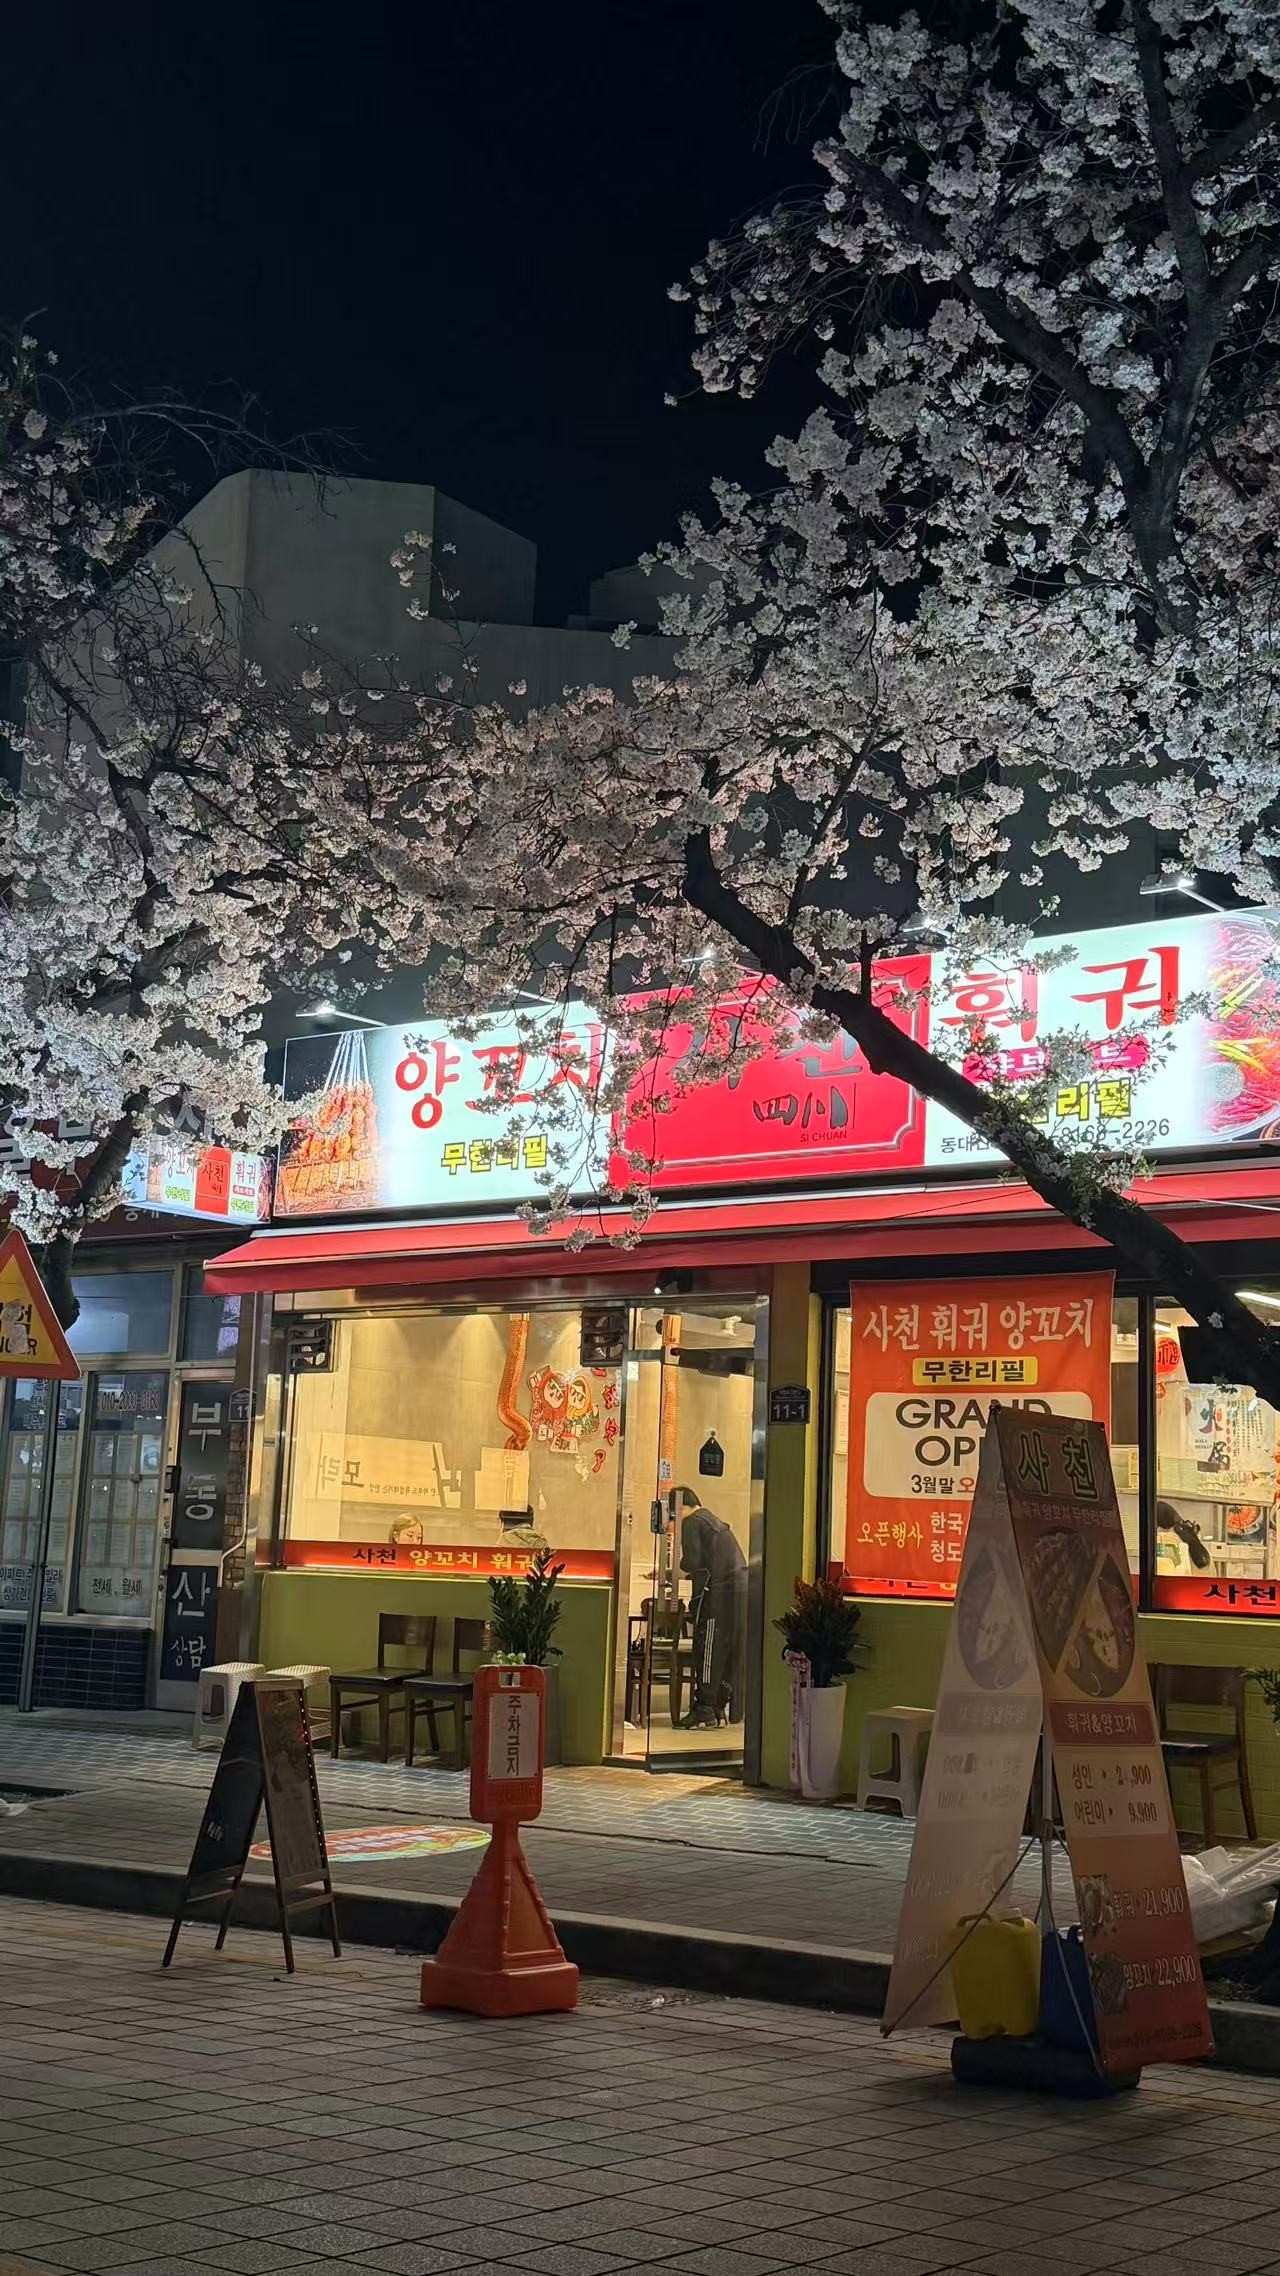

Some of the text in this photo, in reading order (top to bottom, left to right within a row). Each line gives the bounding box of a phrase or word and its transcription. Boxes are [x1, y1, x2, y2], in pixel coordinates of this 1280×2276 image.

[800, 1130, 847, 1143] SI CHUAN
[862, 1299, 1093, 1351] 사천 훠궈 양꼬치
[922, 1359, 1025, 1383] 무한리필
[773, 1404, 805, 1420] 11-1
[915, 1435, 985, 1467] OP
[1017, 1431, 1100, 1500] 사천
[911, 1474, 976, 1494] 3월말 오
[857, 1521, 924, 1549] 오픈행사
[354, 1548, 396, 1565] 사천
[409, 1550, 478, 1569] 양꼬치
[1202, 1583, 1277, 1606] 사천
[170, 1637, 207, 1667] 상담
[507, 1695, 521, 1776] 주차금지
[1143, 1887, 1184, 1917] 21,900
[1154, 1954, 1197, 1988] 22,900
